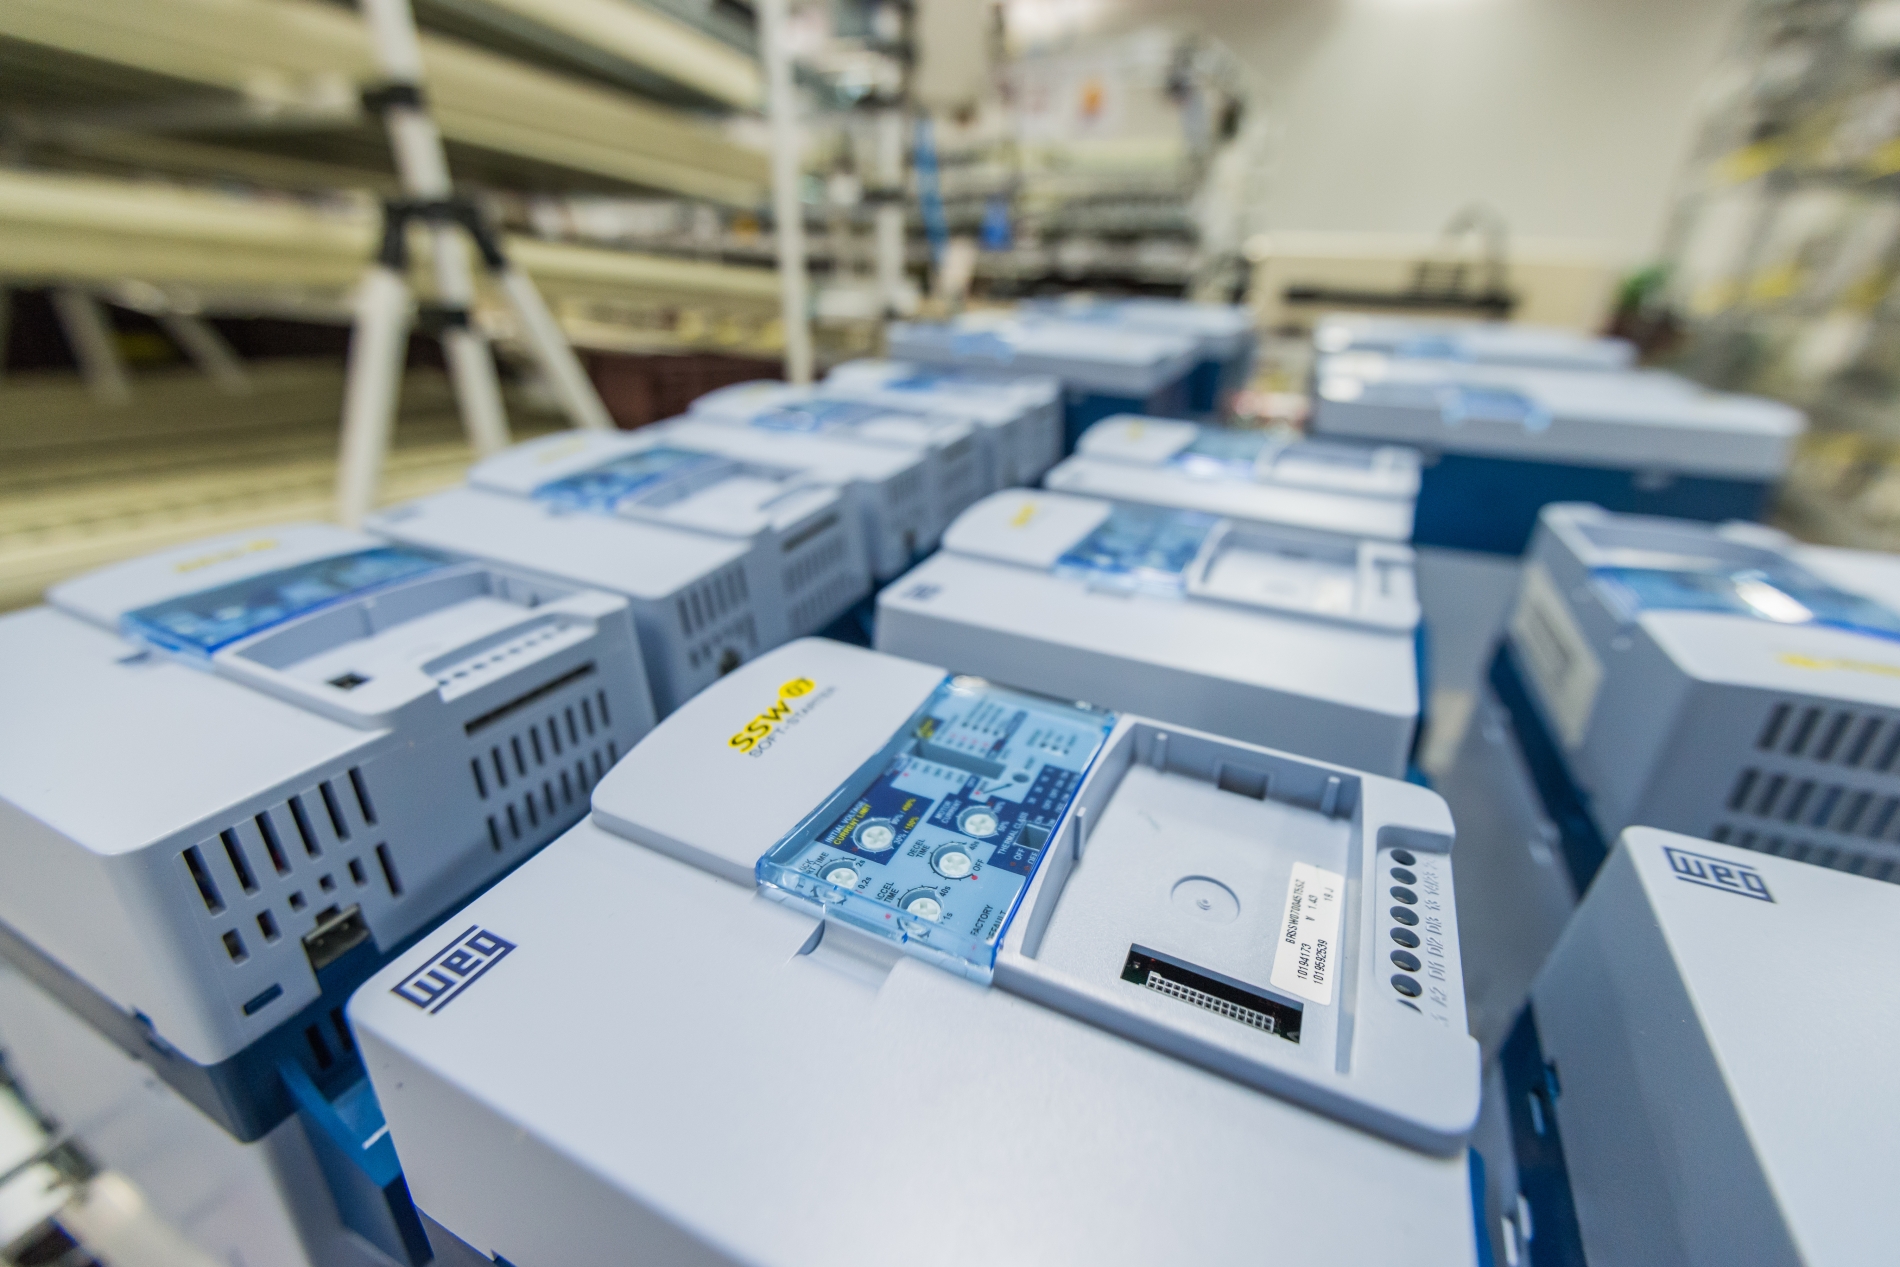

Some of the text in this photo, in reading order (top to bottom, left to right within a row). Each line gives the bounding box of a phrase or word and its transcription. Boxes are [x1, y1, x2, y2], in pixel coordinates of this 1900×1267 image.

[730, 700, 792, 753] SSW
[748, 684, 837, 758] SOFT-STARTER
[935, 801, 952, 819] MOTOR
[941, 800, 962, 824] CURRENT
[825, 825, 845, 843] INITIAL
[841, 801, 865, 824] VOLTAGE
[833, 804, 872, 845] CURRENT LIMIT
[998, 812, 1029, 855] THERMAL CLASS
[907, 839, 925, 857] DECEL
[916, 845, 930, 859] TIME
[969, 841, 980, 851] 40s
[1014, 848, 1026, 861] OFF
[813, 852, 829, 866] TIME
[973, 859, 985, 871] OFF
[884, 888, 899, 903] TIME
[939, 885, 951, 897] 40s
[943, 912, 953, 921] 1s
[970, 904, 994, 937] FACTORY
[1298, 943, 1311, 980] 10194173
[1313, 939, 1328, 985] 1019592539
